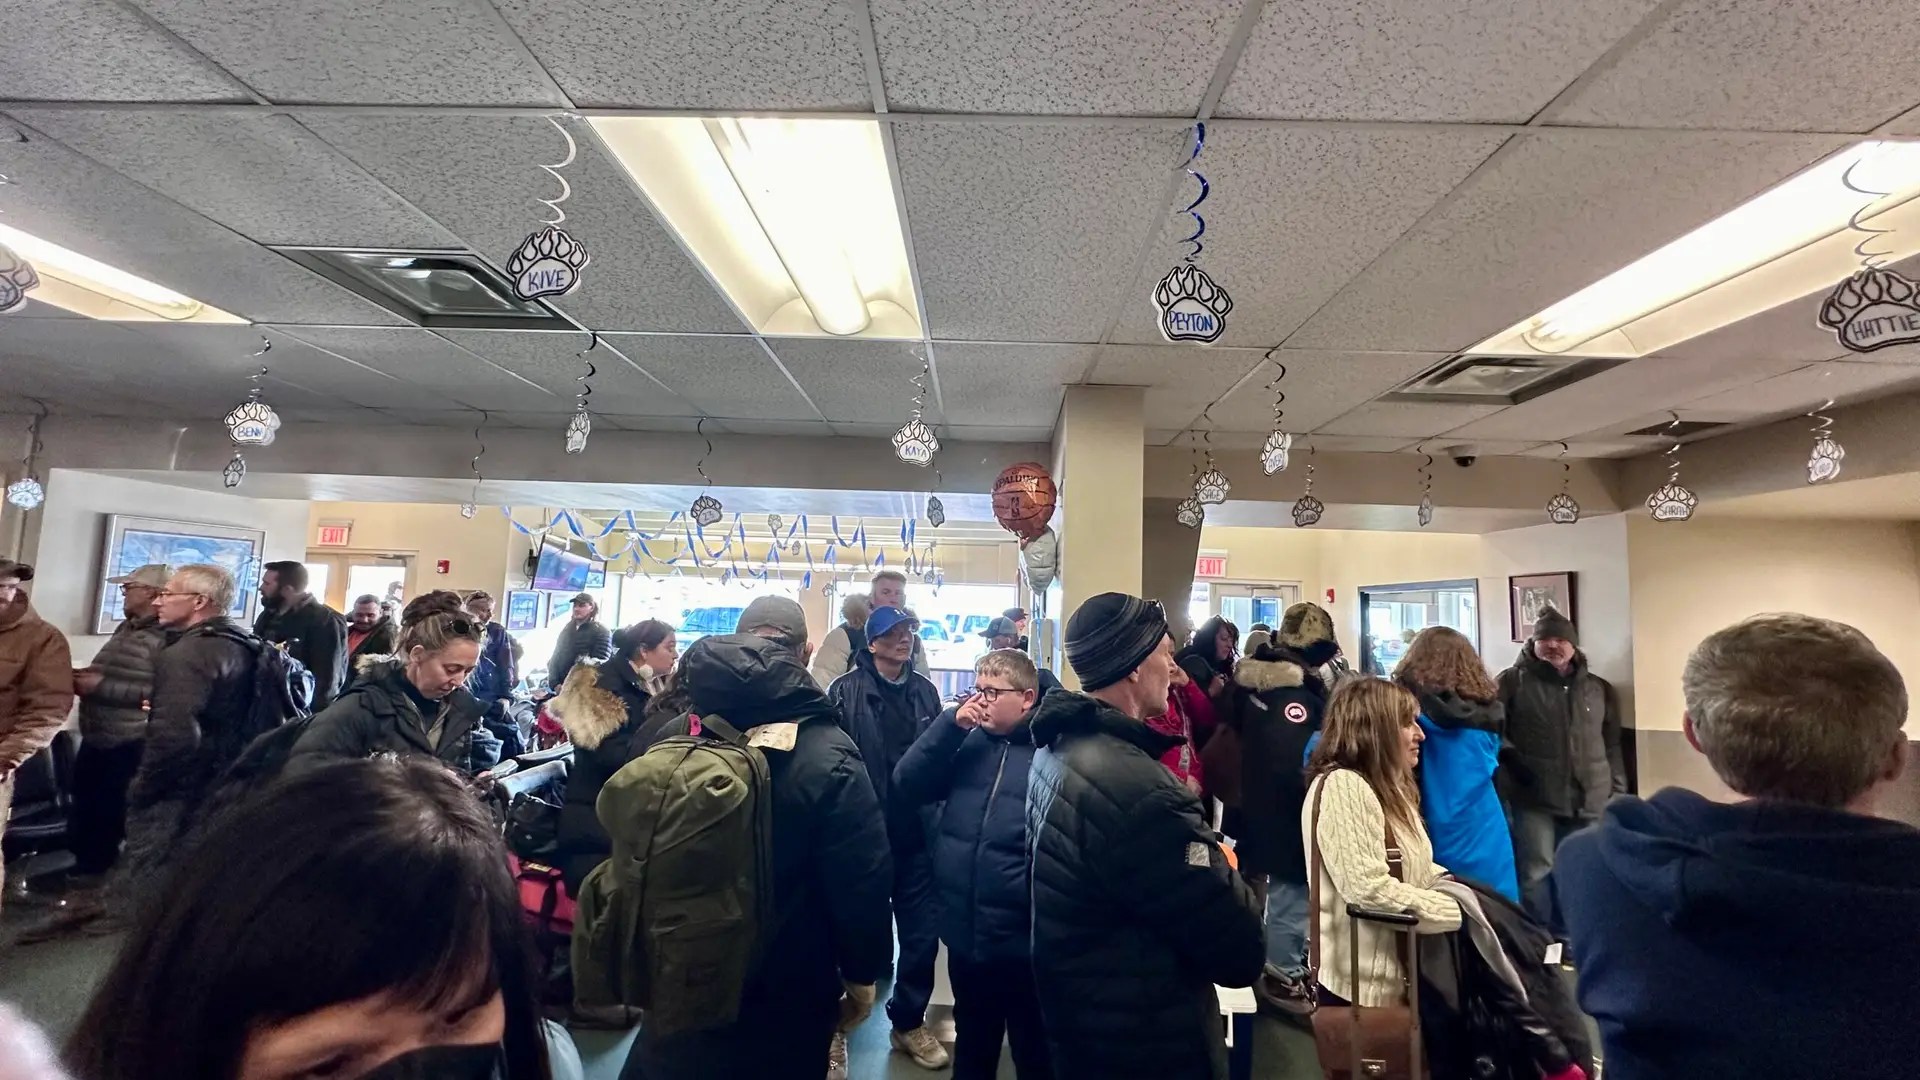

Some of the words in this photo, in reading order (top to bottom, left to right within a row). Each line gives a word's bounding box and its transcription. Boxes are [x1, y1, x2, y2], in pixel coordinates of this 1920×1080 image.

[529, 269, 566, 291] KIVE
[1169, 310, 1213, 332] PEYTON
[1851, 313, 1920, 341] HATTIE
[905, 444, 926, 457] KAYA
[1202, 488, 1221, 501] SAGE
[1658, 505, 1688, 516] SARAH
[322, 528, 344, 543] EXIT
[1199, 559, 1223, 575] EXIT
